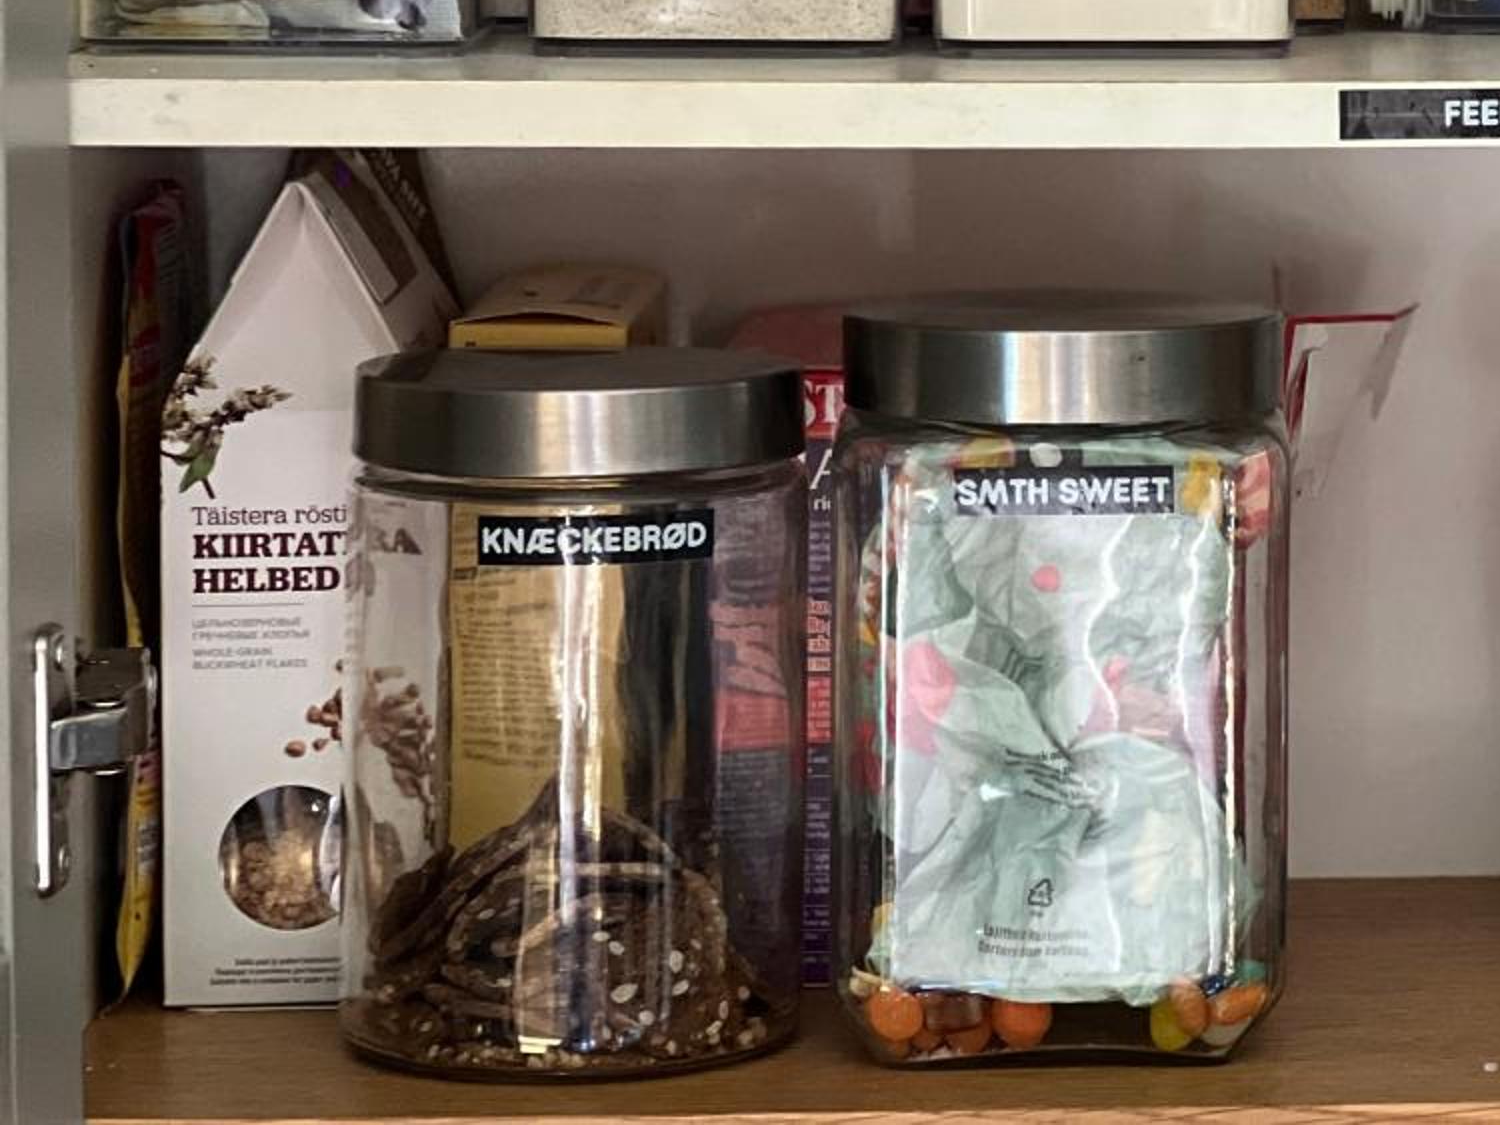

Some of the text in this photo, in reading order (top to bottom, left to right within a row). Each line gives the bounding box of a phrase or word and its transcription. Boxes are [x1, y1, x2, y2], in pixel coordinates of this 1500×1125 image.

[957, 476, 1169, 507] SMTH SWEET
[193, 507, 347, 525] Täistera rösti
[481, 520, 707, 555] KNÆCKEBRØD
[193, 567, 340, 593] HELBED
